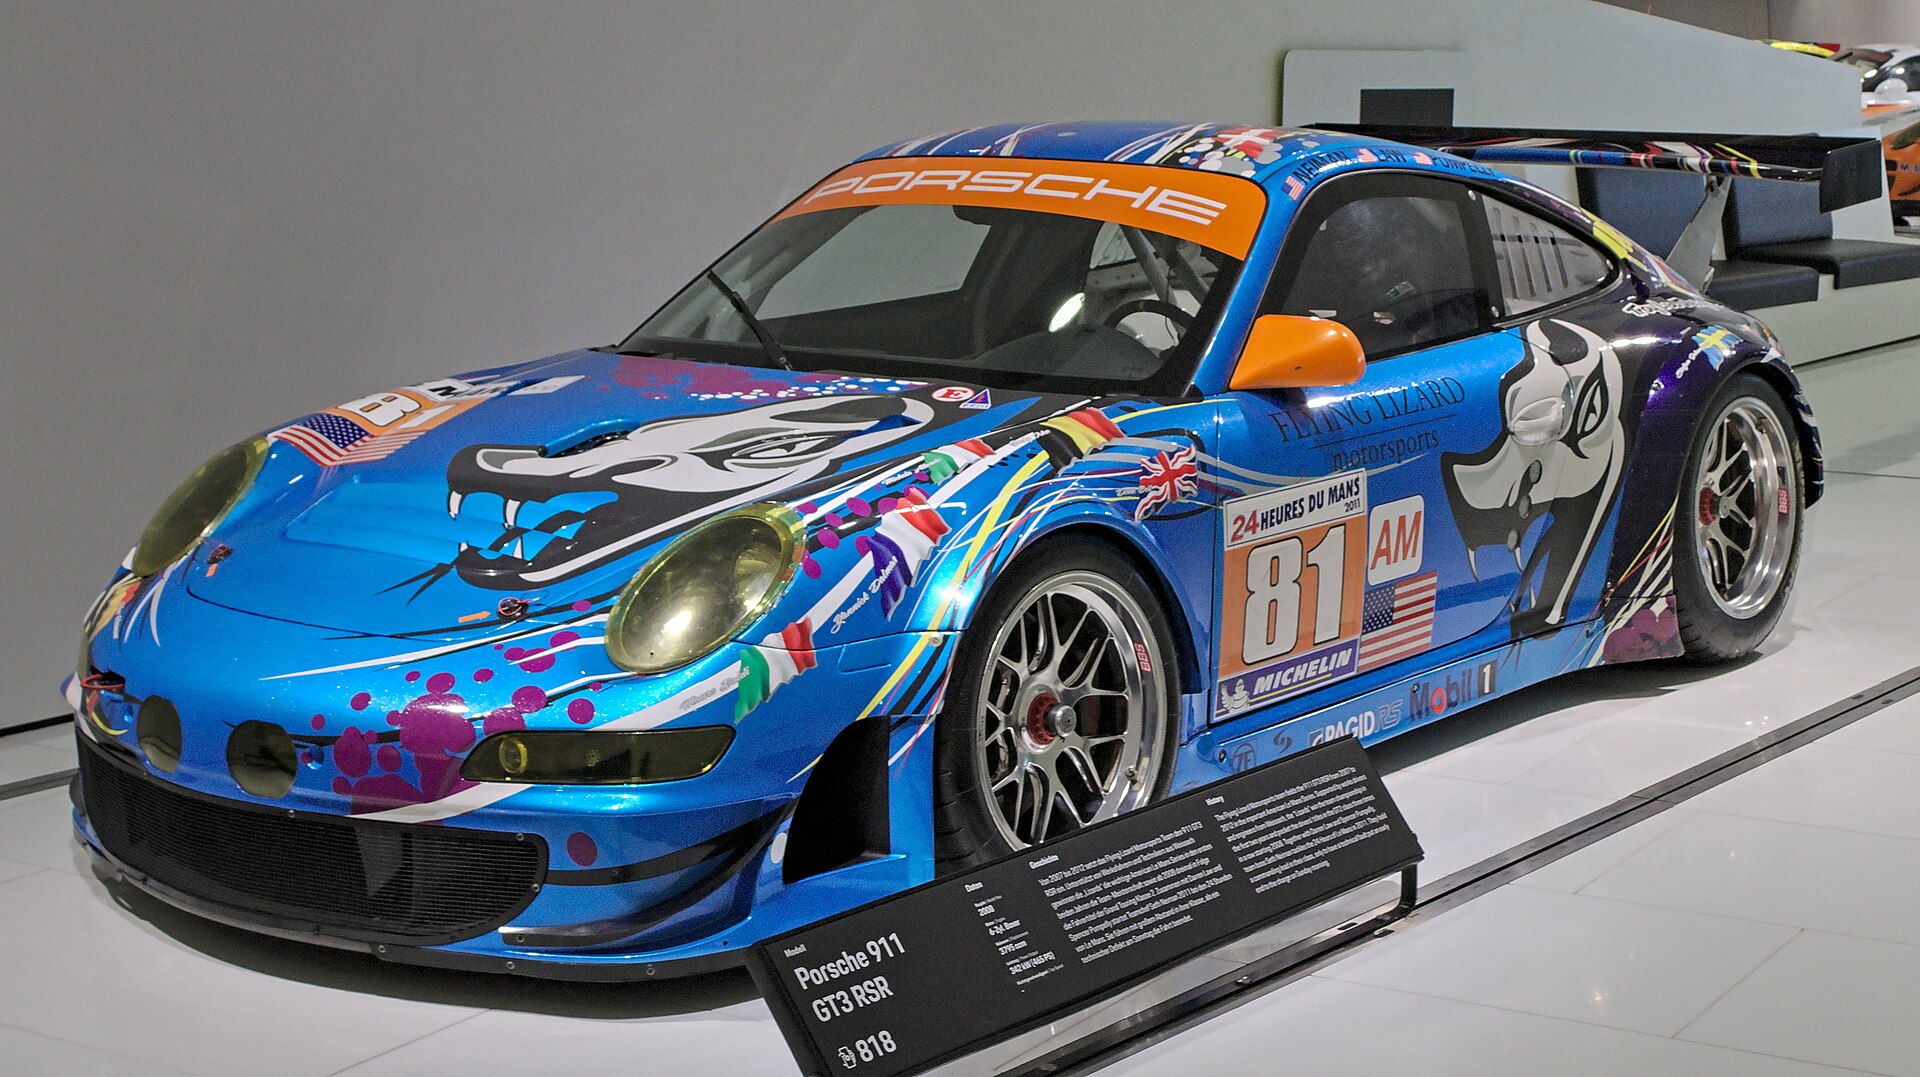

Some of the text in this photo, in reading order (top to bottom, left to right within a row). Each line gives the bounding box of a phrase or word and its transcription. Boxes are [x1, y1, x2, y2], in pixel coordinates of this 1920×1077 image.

[1373, 149, 1407, 163] LAW
[804, 169, 1228, 226] PORSCHE
[937, 389, 968, 399] E
[1268, 376, 1466, 442] FLYING LIZARD
[1332, 429, 1440, 472] motorsports
[1230, 476, 1361, 543] 24 HEURES DU MANS
[1344, 498, 1361, 513] 2011
[1370, 510, 1422, 571] AM
[1242, 523, 1347, 667] 81
[1134, 642, 1152, 672] BBS
[1252, 647, 1354, 696] MICHELIN
[1409, 668, 1473, 721] Mobil
[1325, 711, 1376, 740] PAGID
[793, 932, 906, 990] Porsche 911
[811, 975, 894, 1022] GT3 RSR
[855, 1030, 897, 1063] 818
